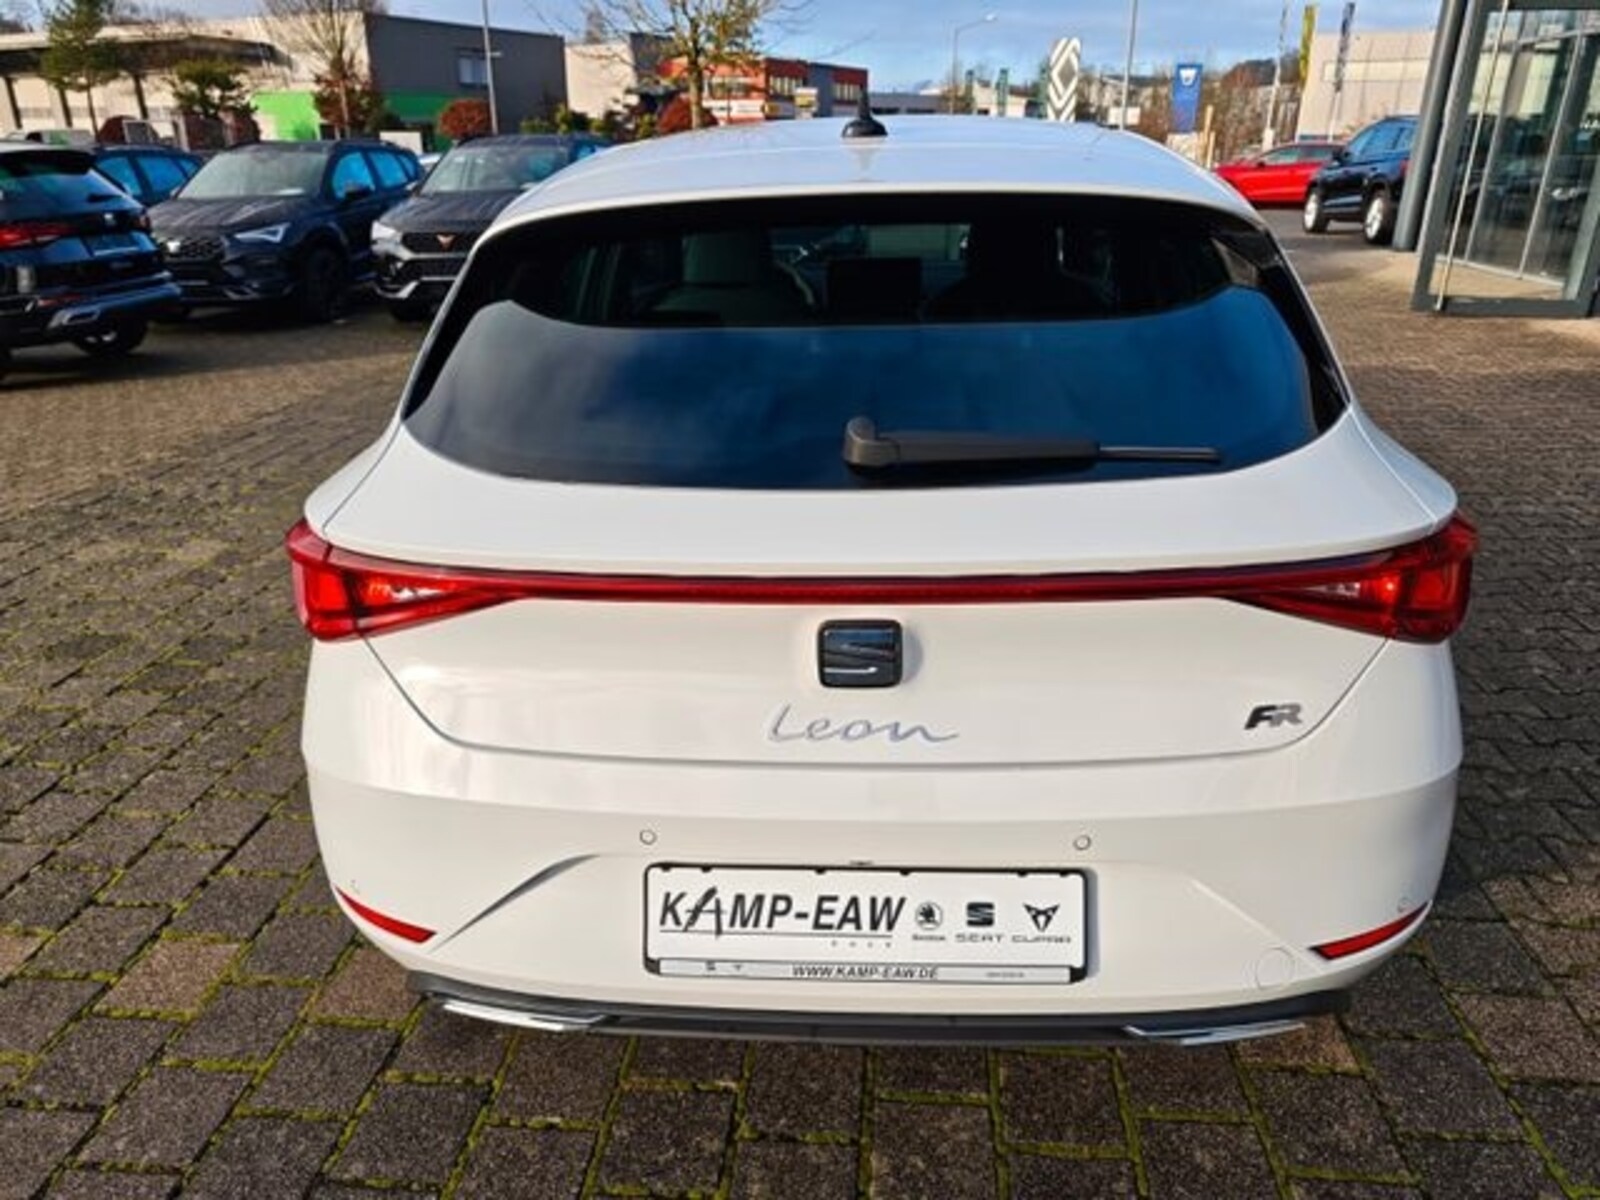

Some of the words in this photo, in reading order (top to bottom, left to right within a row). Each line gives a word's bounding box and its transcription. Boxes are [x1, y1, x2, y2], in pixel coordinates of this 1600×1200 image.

[767, 704, 959, 743] Leon
[1244, 702, 1303, 730] FR
[659, 886, 907, 938] KAMP-EAW
[955, 932, 1005, 943] SEAT
